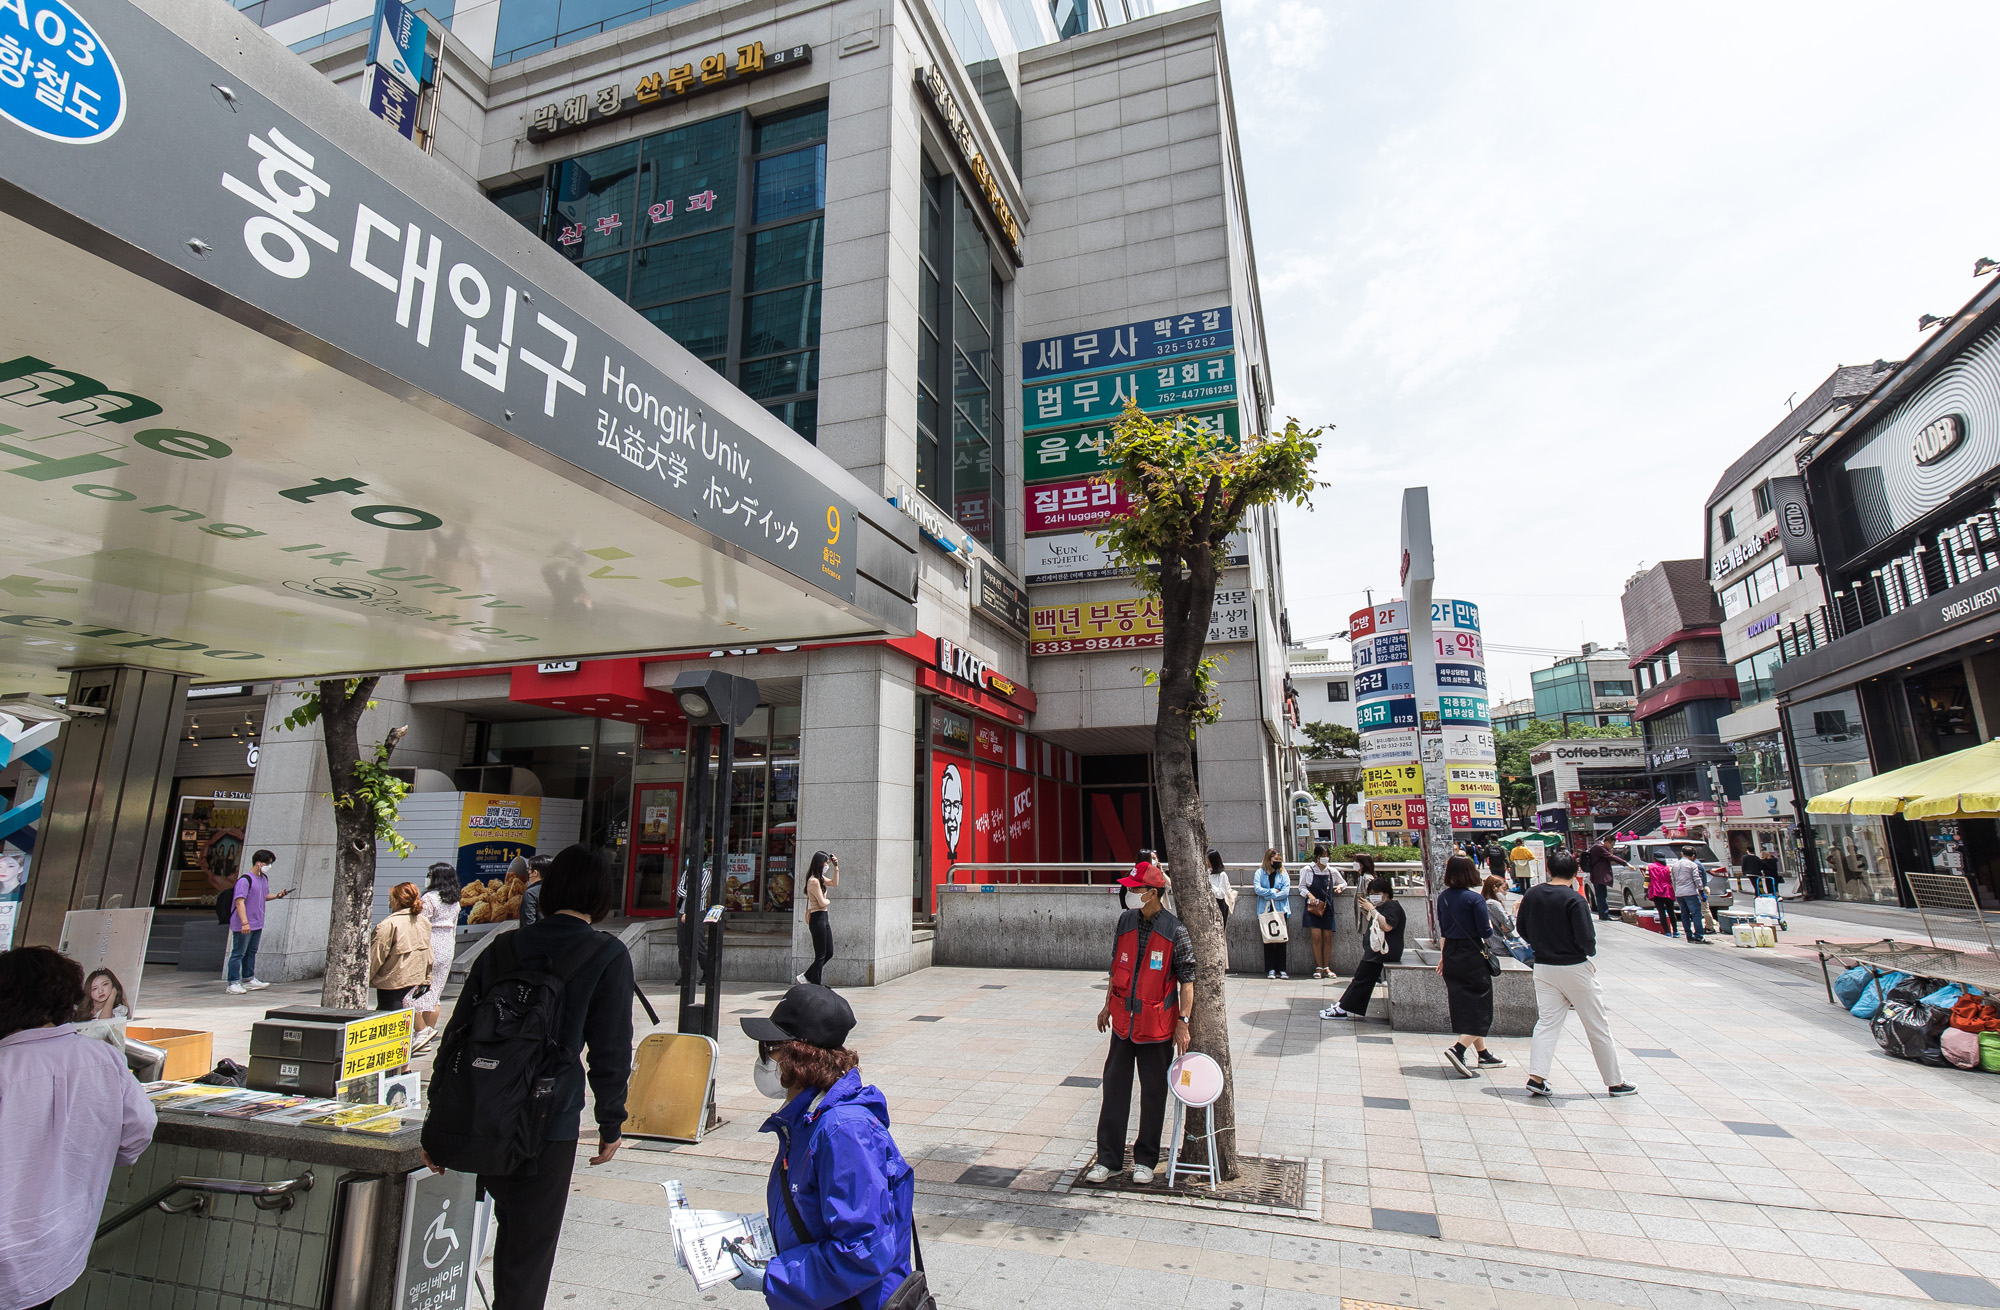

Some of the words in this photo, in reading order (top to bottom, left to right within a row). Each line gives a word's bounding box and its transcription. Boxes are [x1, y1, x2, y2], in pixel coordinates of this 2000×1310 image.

[0, 34, 101, 130] 항철도
[534, 84, 622, 132] 박혜정
[636, 41, 766, 105] 산부인과
[222, 127, 586, 417] 홍대입구
[1036, 326, 1138, 370] 세무사
[1154, 311, 1220, 338] 박수갑
[1157, 336, 1216, 355] 325-5252
[1037, 374, 1139, 419] 법무사
[1157, 359, 1225, 388] 김회규
[1158, 384, 1233, 403] 752-4477(612호)
[602, 355, 696, 450] Hongik
[701, 422, 753, 485] Univ.
[597, 408, 688, 489] 弘益大学
[1034, 482, 1116, 514] 짐프리
[702, 475, 799, 550] ホンディック
[896, 485, 944, 539] kinko's
[1045, 513, 1065, 525] 24H
[1068, 508, 1110, 522] luggage
[1786, 503, 1805, 536] FOLDER
[826, 505, 840, 545] 9
[823, 546, 841, 568] 출입구
[822, 564, 841, 581] Entrance
[1034, 607, 1081, 637] 백년
[1087, 600, 1163, 633] 부동산
[1432, 604, 1450, 621] 2F
[1941, 598, 1970, 621] SHOES
[1351, 615, 1369, 632] C방
[1379, 610, 1395, 625] 2F
[955, 647, 987, 689] KFC
[943, 717, 953, 738] 24
[1394, 715, 1414, 724] 612호
[1450, 747, 1478, 756] PILATES
[1557, 747, 1598, 758] Coffee
[1599, 747, 1639, 757] Brown
[213, 790, 227, 798] EYE
[1013, 787, 1032, 818] KFC
[1383, 803, 1402, 816] 직방
[1408, 804, 1425, 813] 지하
[1451, 803, 1468, 812] 지하
[1474, 801, 1497, 816] 백년
[1268, 919, 1280, 937] C
[281, 1065, 298, 1075] 교차로
[409, 1261, 464, 1304] 엘리베이터
